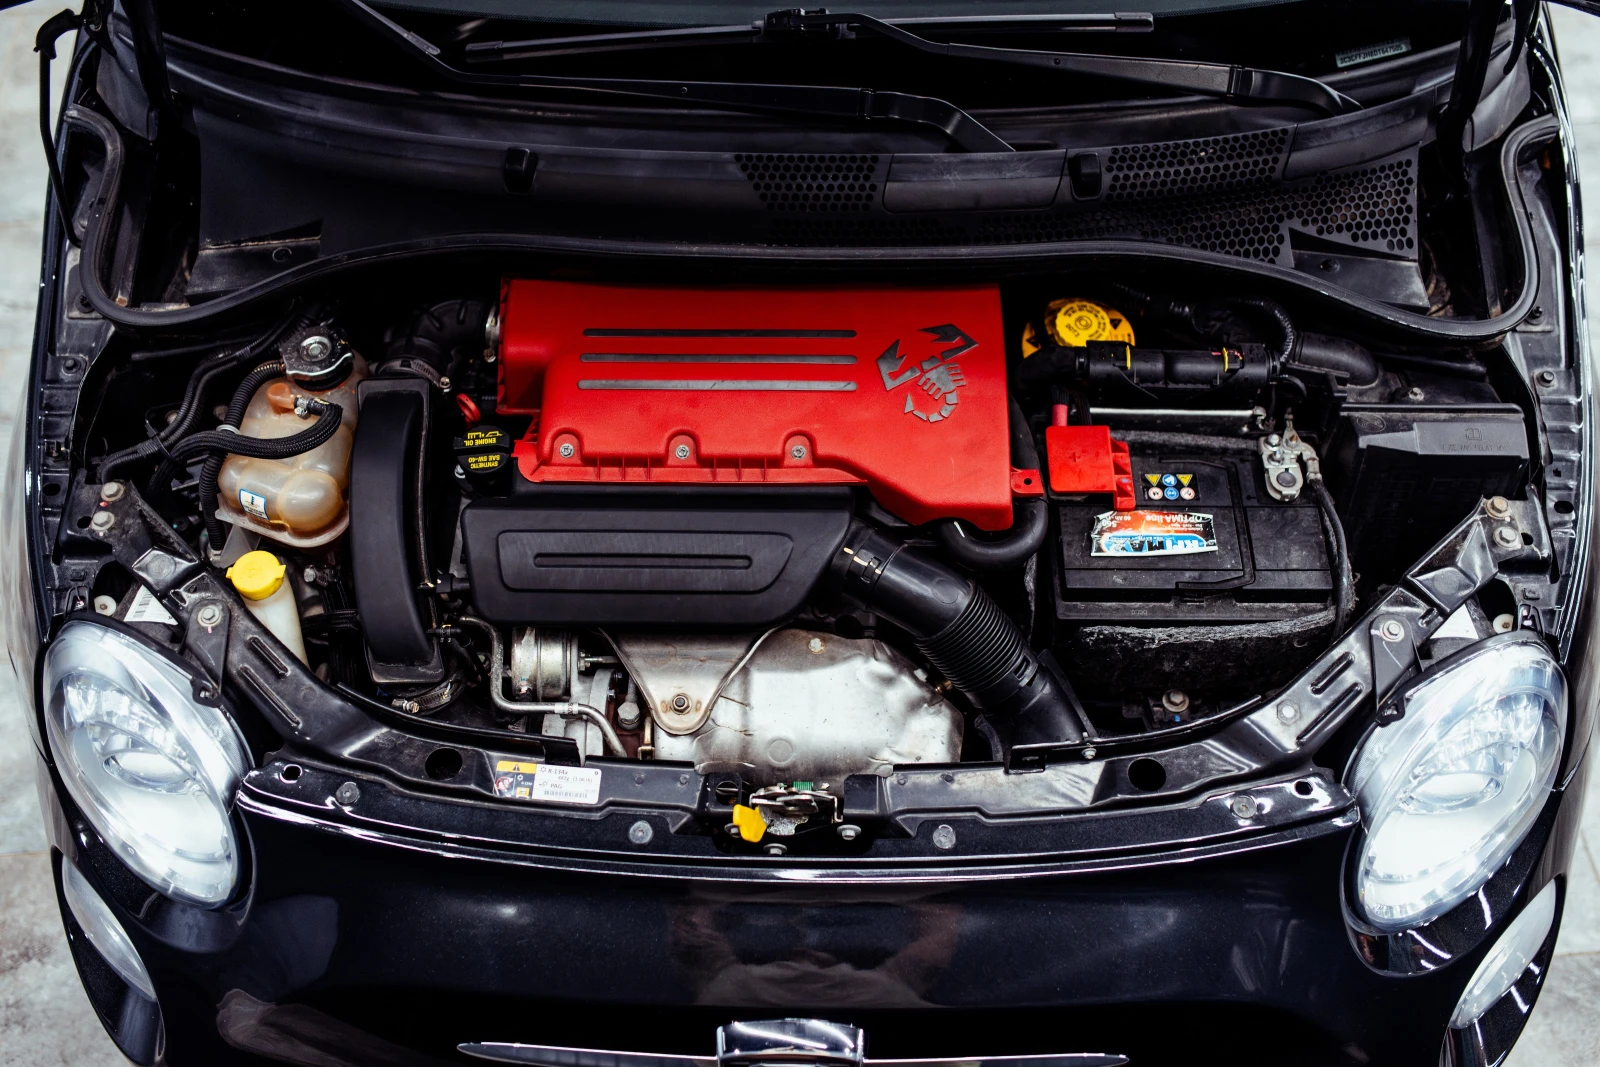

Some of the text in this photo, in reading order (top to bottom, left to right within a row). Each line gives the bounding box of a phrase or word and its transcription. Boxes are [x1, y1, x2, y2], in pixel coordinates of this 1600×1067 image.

[463, 437, 496, 447] ENGINE OIL
[468, 455, 487, 463] 5W-40
[470, 461, 498, 469] SYNTHETIC
[1145, 514, 1203, 523] OPTIMA line
